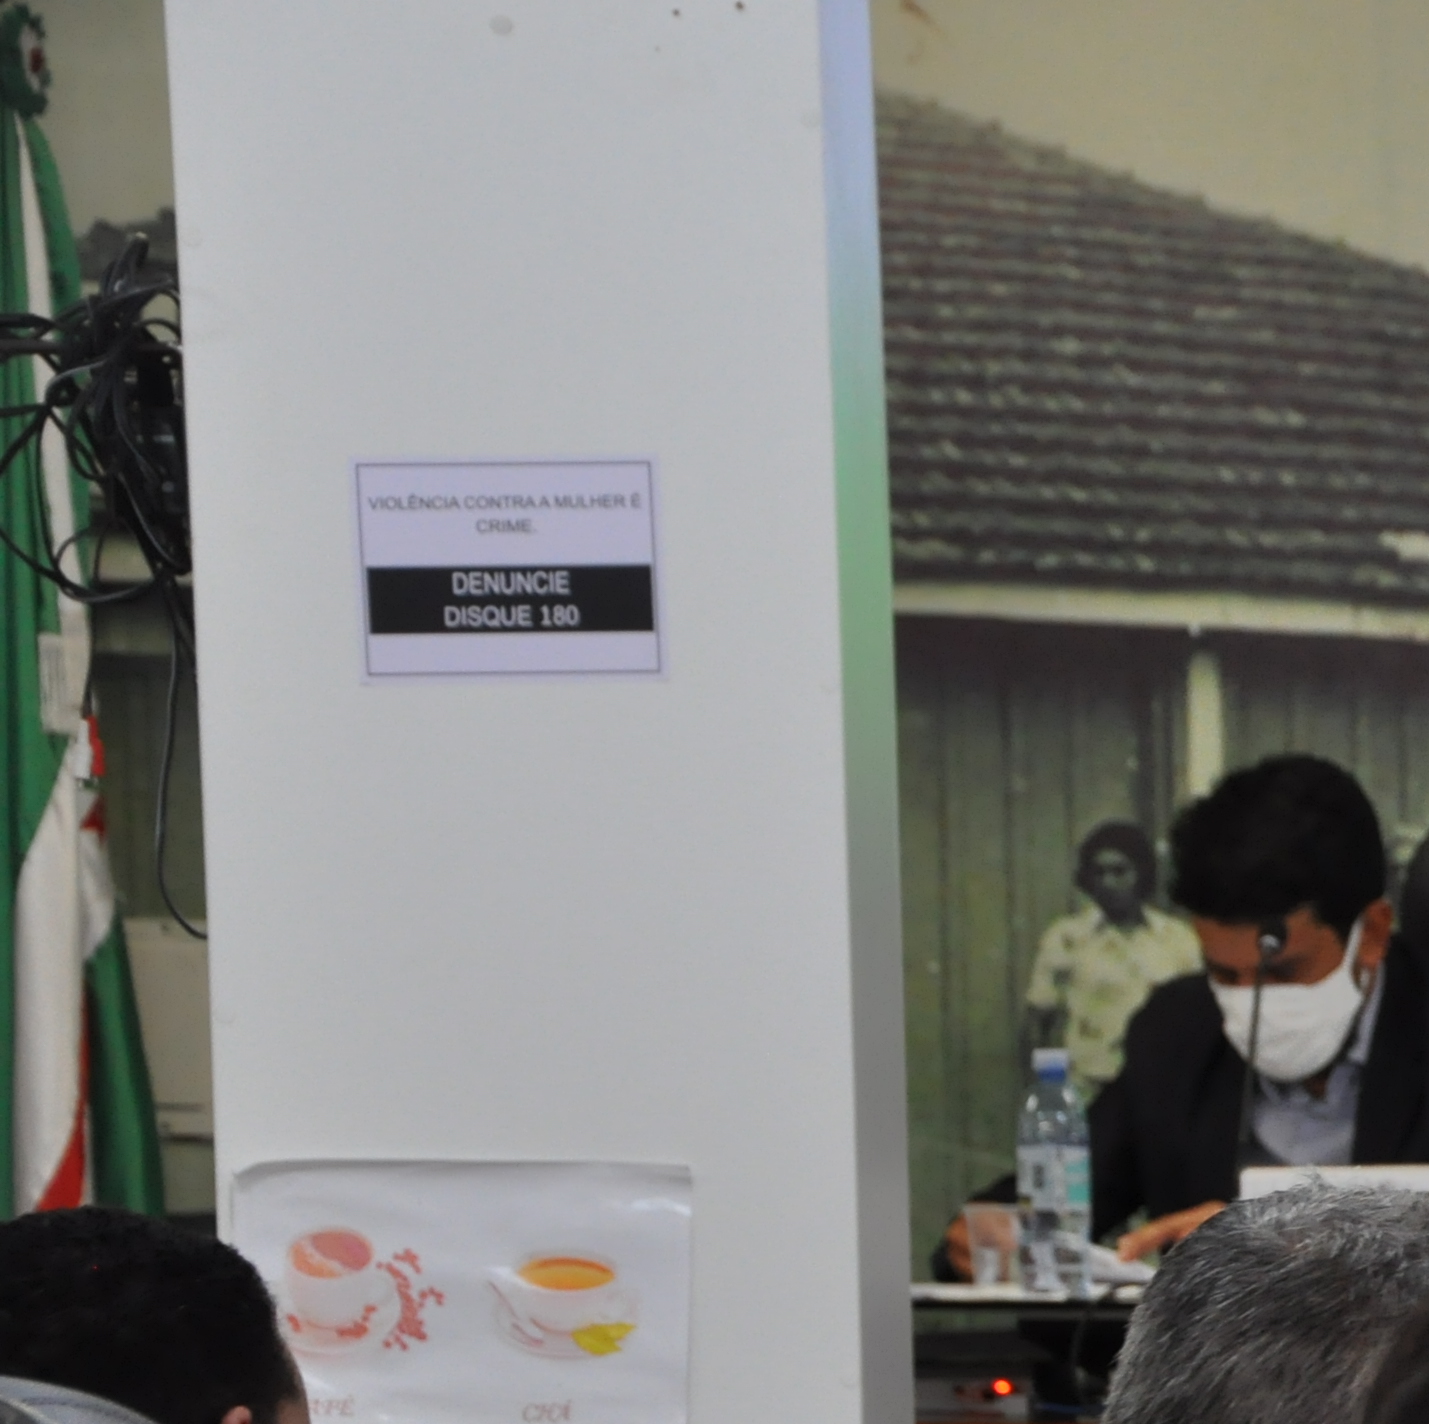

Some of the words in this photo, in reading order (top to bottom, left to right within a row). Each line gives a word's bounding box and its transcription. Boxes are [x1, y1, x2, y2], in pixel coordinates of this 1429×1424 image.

[368, 493, 459, 511] VIOLÊNCIA
[464, 493, 539, 510] CONTRA
[539, 493, 551, 508] A
[554, 493, 626, 508] MULHER
[475, 518, 538, 535] CRIME.
[451, 570, 571, 595] DENUNCIE
[443, 605, 533, 630] DISQUE
[540, 604, 581, 627] 180
